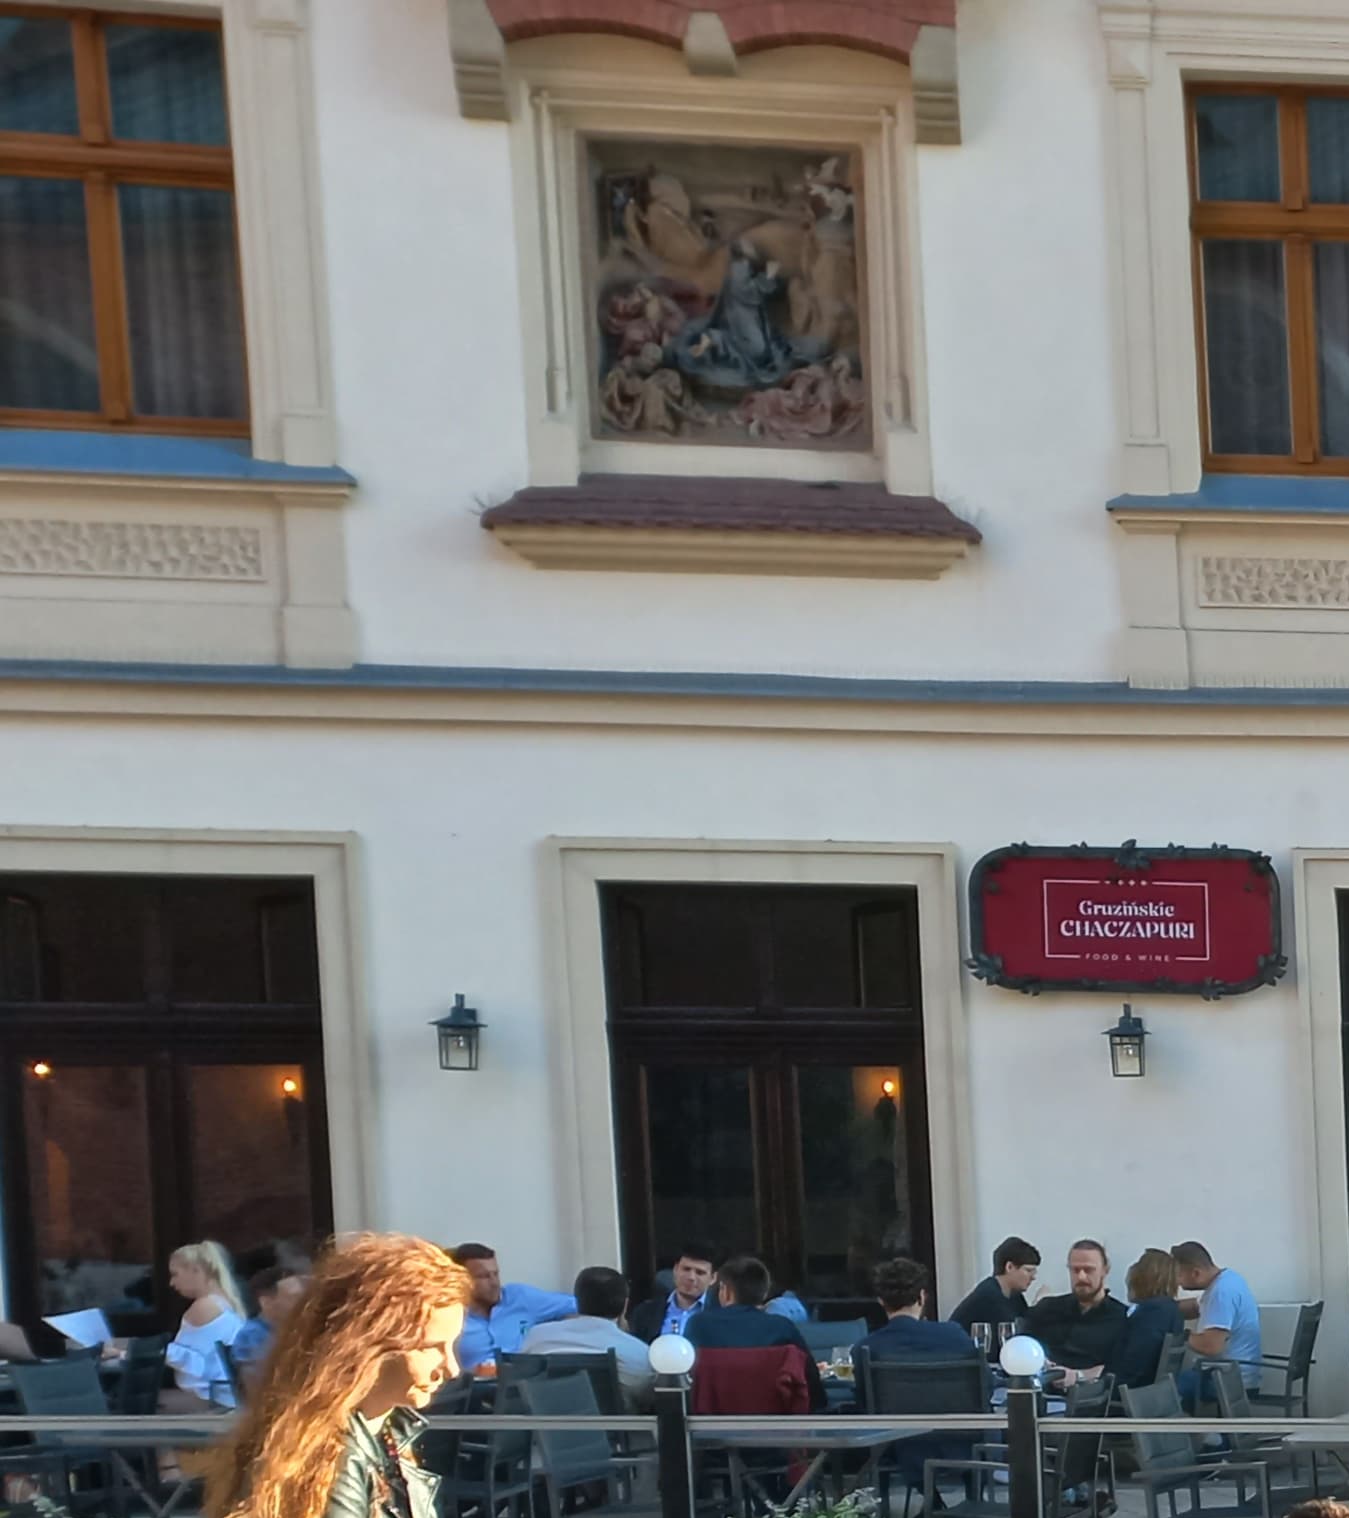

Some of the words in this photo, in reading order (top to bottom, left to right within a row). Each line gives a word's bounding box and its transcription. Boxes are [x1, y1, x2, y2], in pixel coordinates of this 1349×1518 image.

[1079, 899, 1175, 917] Gruzińskie
[1060, 919, 1195, 940] CHACZAPURI
[1085, 953, 1119, 961] FOOD
[1138, 954, 1170, 962] WINE
